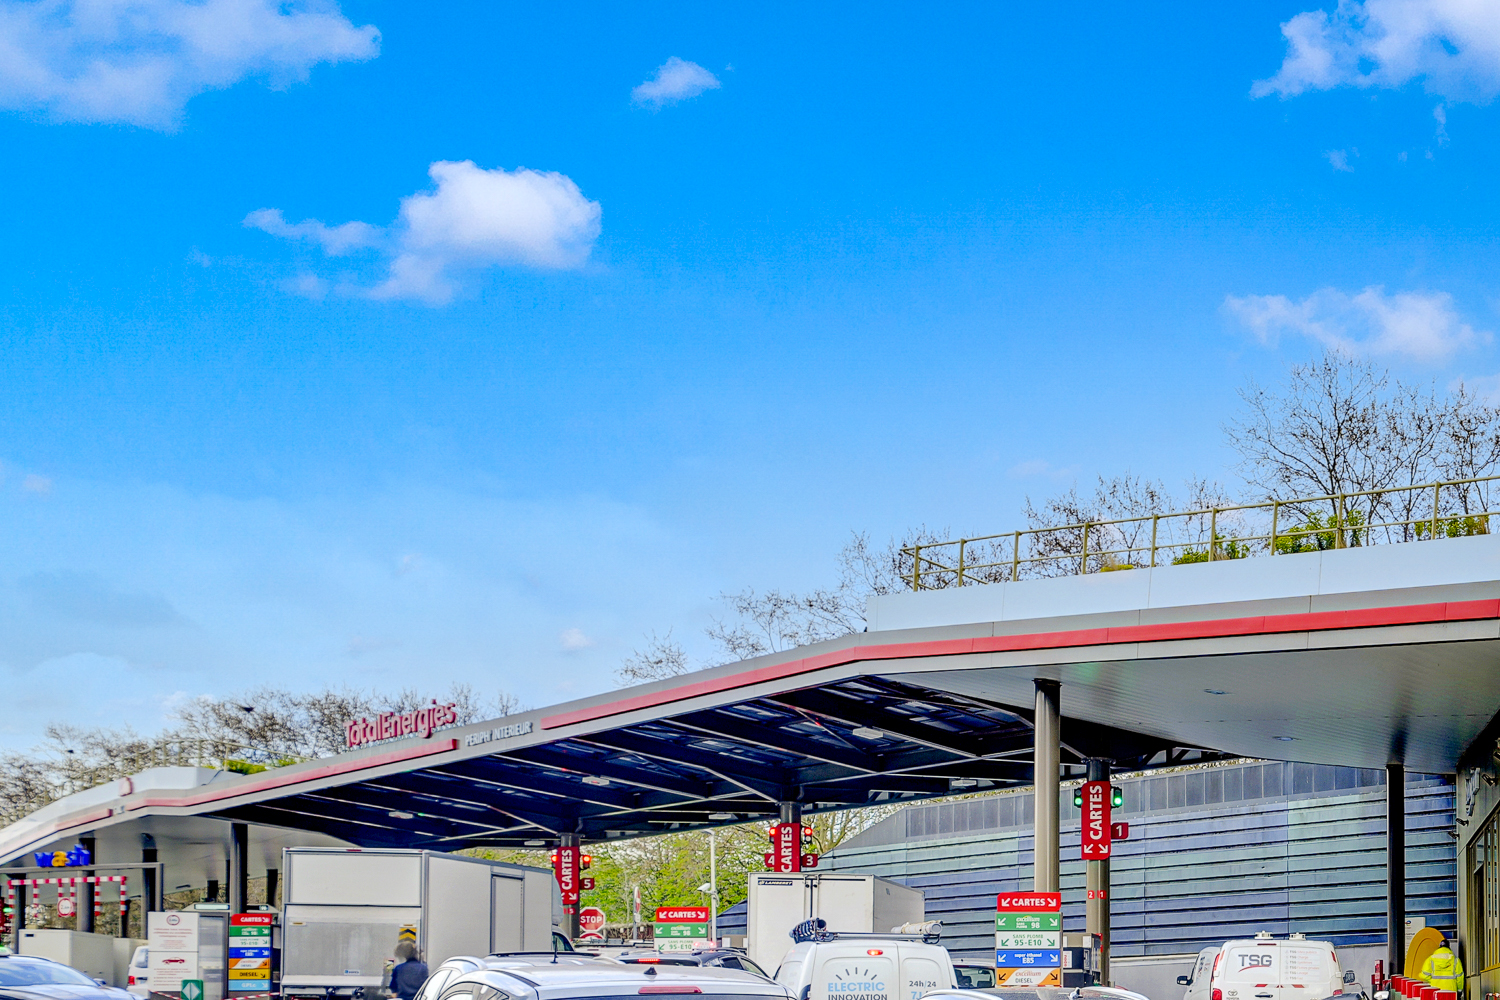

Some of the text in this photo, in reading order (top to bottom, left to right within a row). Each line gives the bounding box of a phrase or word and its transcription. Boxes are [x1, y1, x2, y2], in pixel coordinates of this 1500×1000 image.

[343, 699, 456, 747] TotalEnergies
[492, 722, 534, 741] INTERIEUR
[1090, 785, 1102, 840] CARTES
[1116, 825, 1122, 837] 1
[780, 826, 792, 873] CARTES
[767, 855, 775, 866] 4
[806, 855, 813, 866] 3
[561, 849, 573, 890] CARTES
[584, 879, 591, 888] 5
[1012, 898, 1046, 906] CARTES
[580, 915, 602, 924] STOP
[1238, 954, 1272, 967] TSG
[827, 982, 885, 992] ELECTRIC
[909, 980, 937, 988] 24h/24
